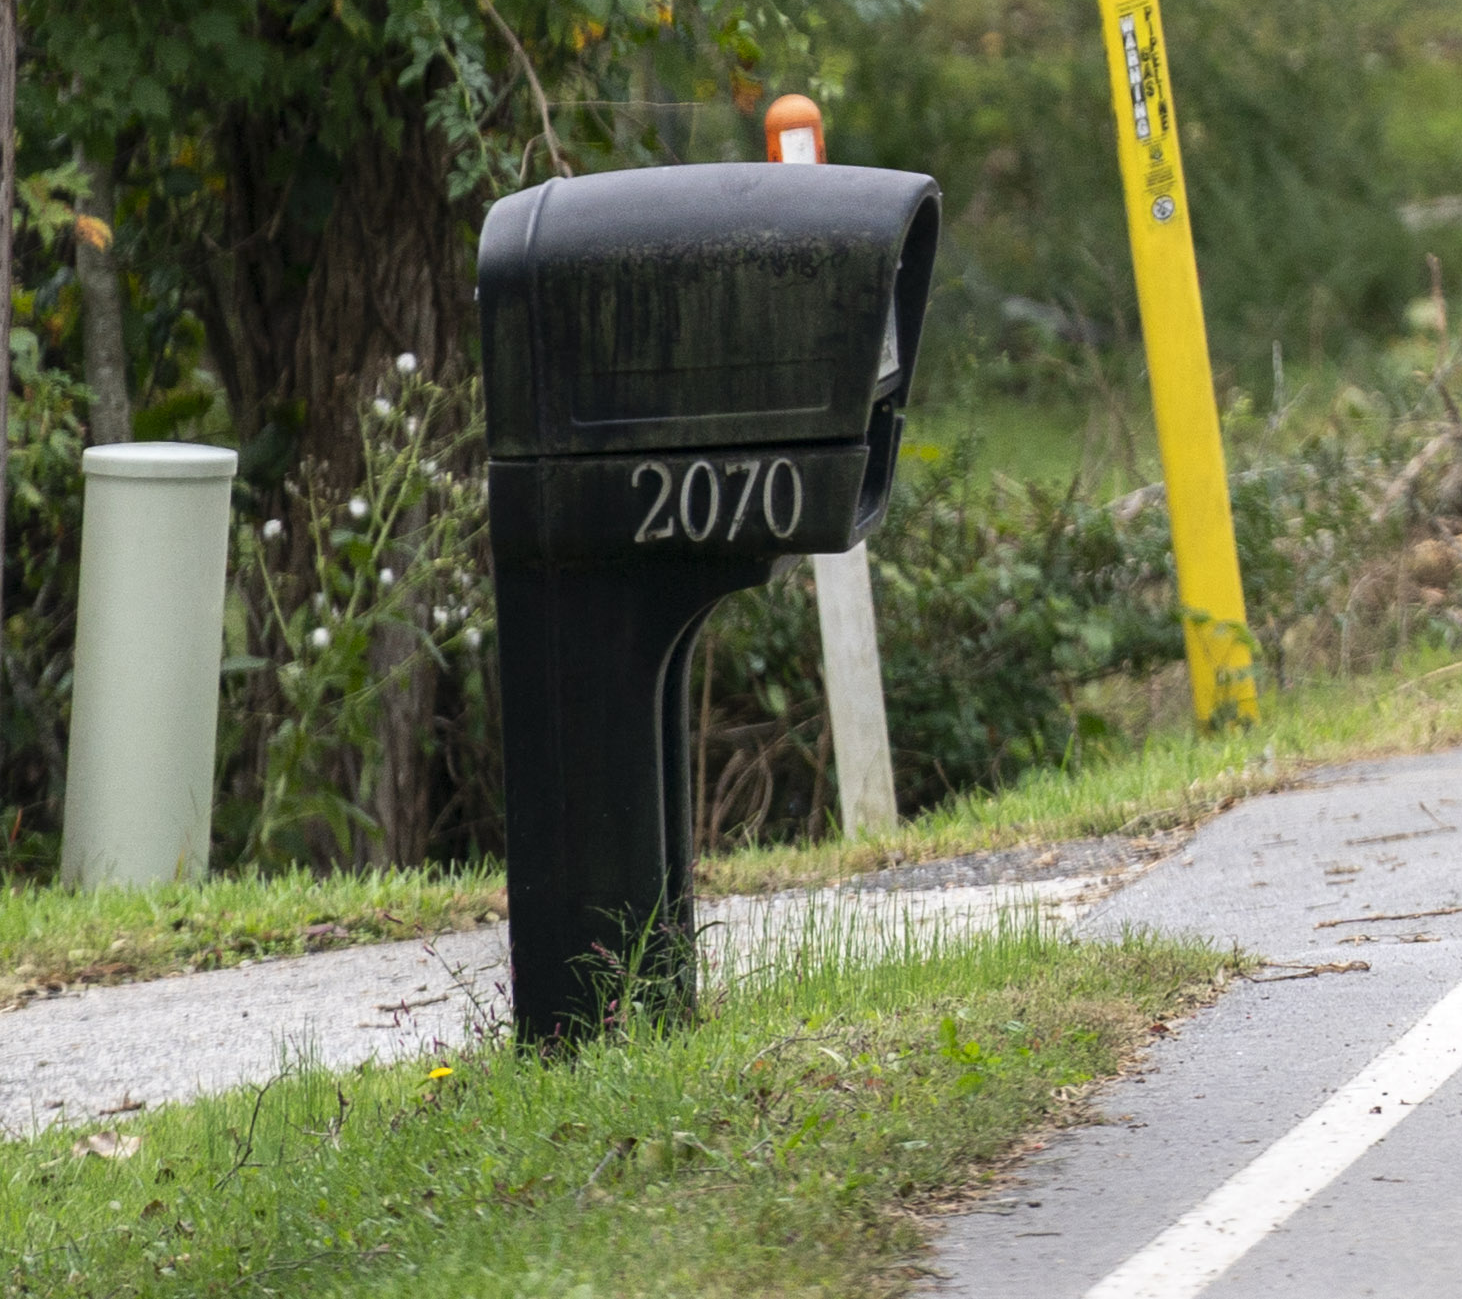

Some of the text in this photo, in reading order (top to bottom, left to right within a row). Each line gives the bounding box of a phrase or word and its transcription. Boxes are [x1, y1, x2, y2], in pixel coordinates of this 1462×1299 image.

[1118, 14, 1149, 139] WARNING
[1141, 47, 1155, 97] GAS
[1144, 6, 1168, 131] PIPELINE
[632, 458, 802, 542] 2070
